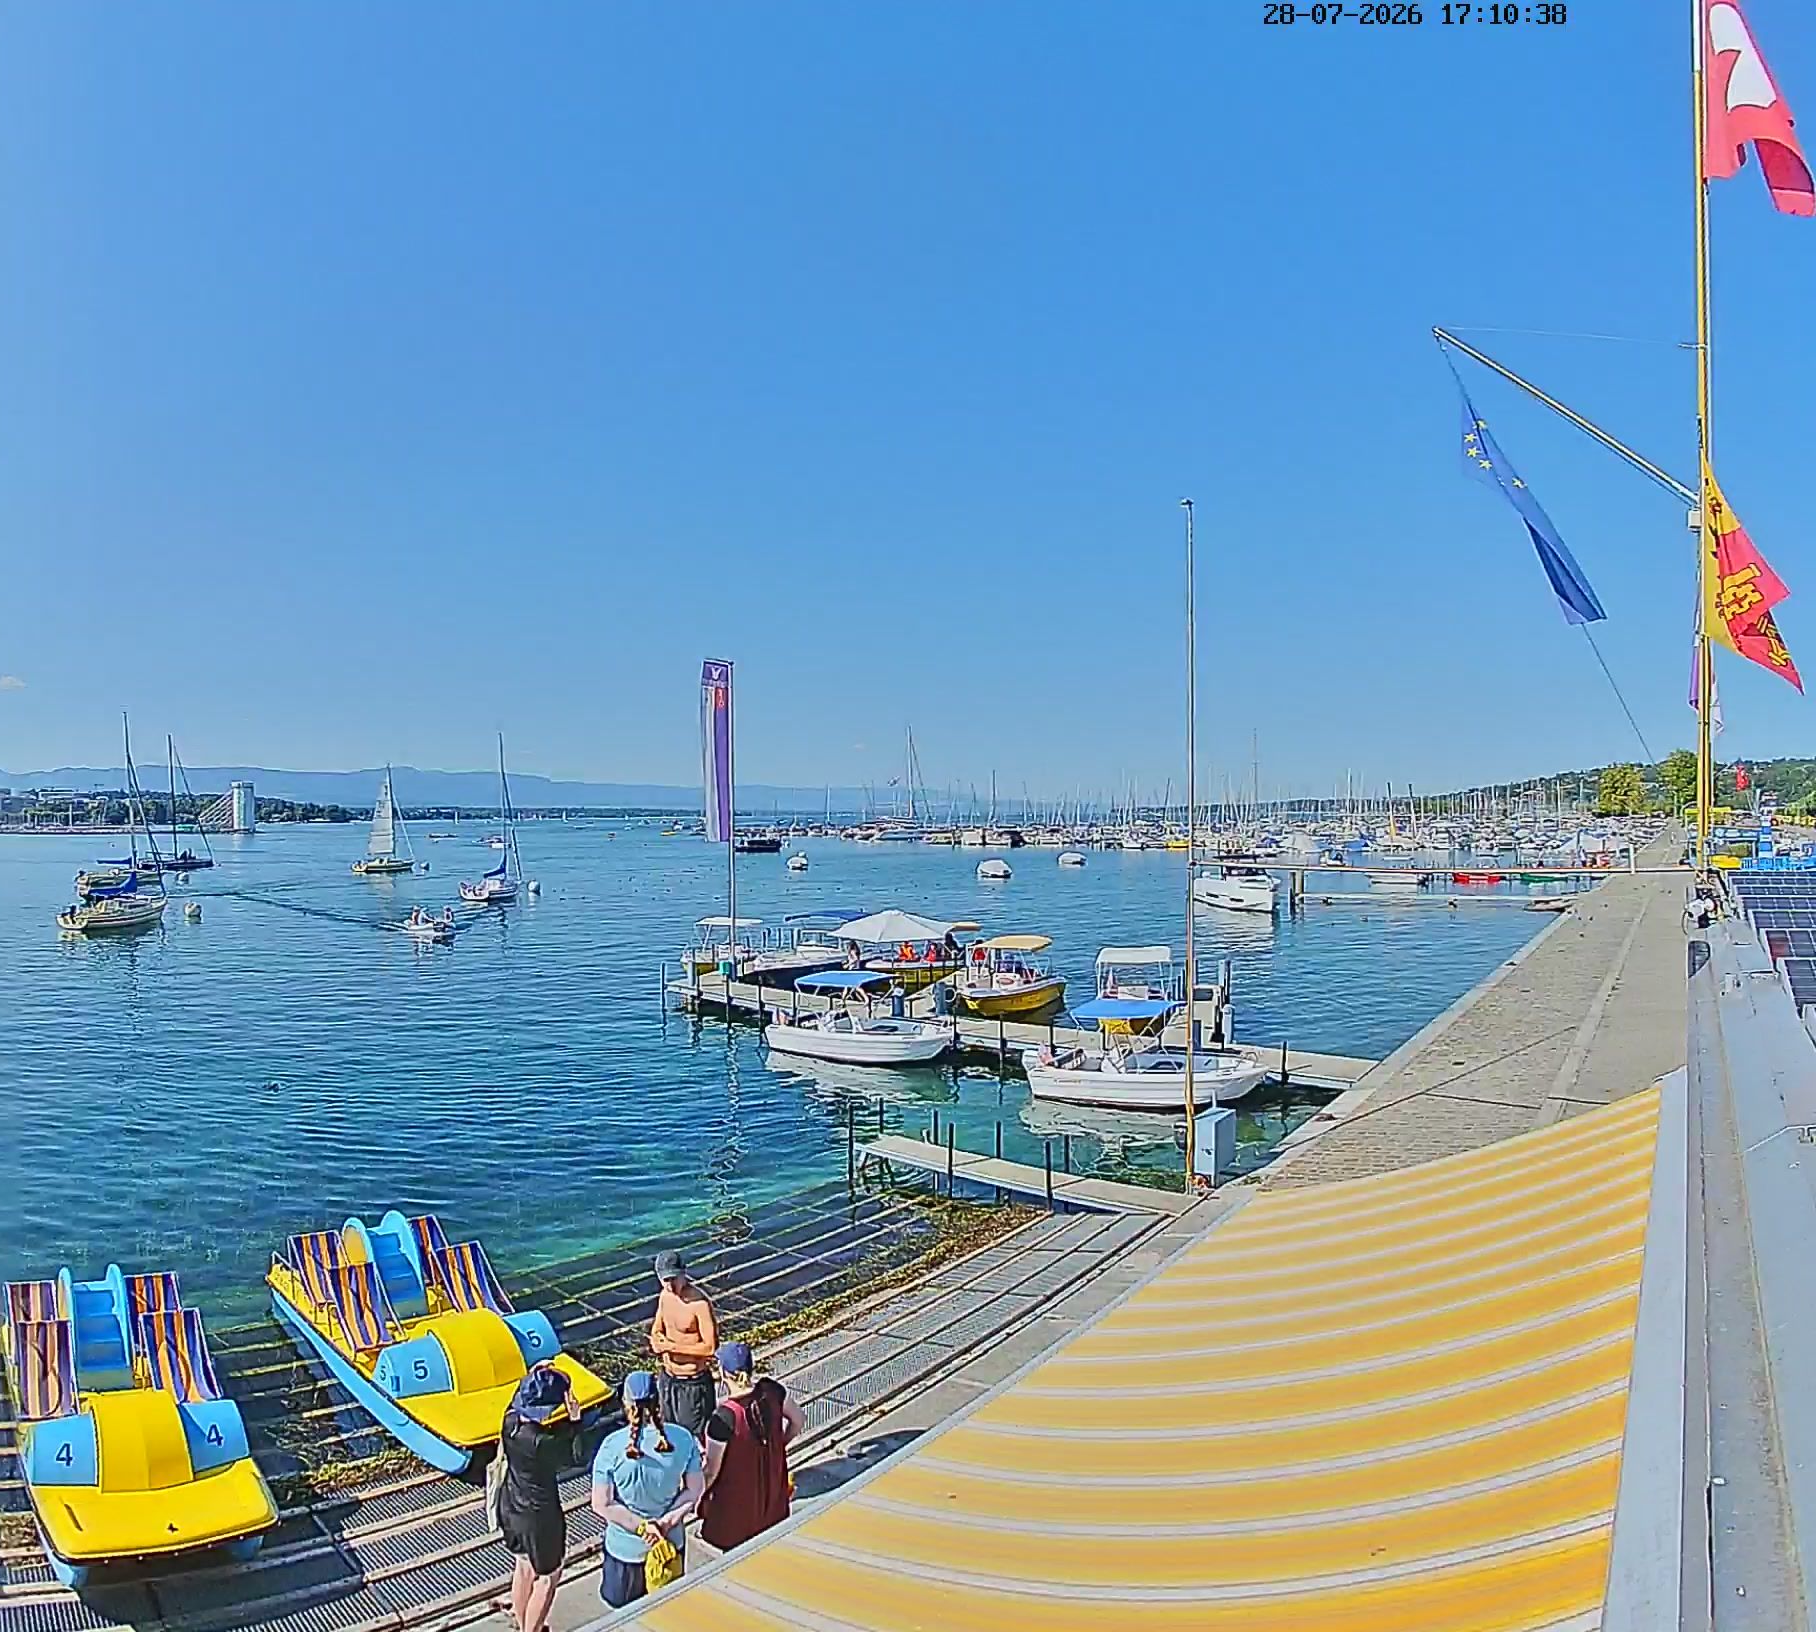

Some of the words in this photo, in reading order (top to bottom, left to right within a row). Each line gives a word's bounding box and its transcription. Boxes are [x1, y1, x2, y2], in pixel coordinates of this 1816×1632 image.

[527, 1330, 542, 1348] 5
[413, 1359, 429, 1380] 5
[206, 1424, 223, 1445] 4
[56, 1443, 73, 1466] 4
